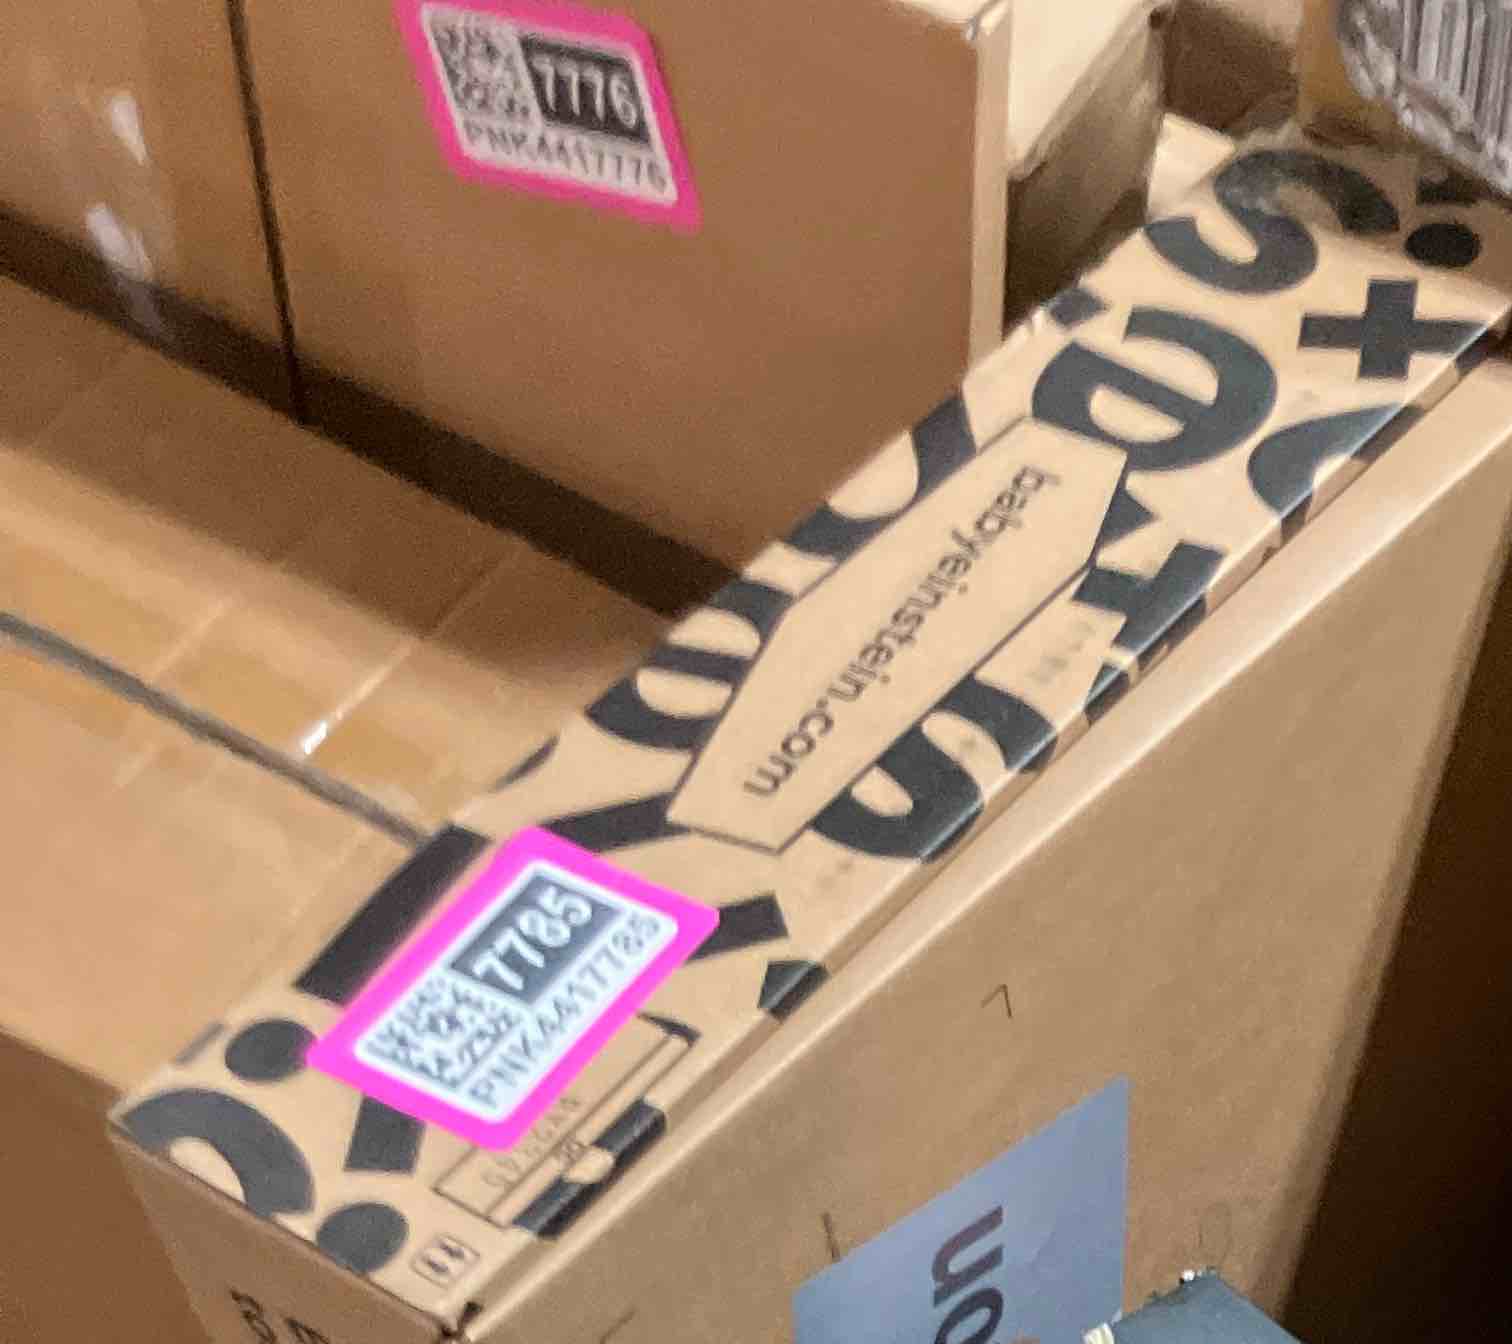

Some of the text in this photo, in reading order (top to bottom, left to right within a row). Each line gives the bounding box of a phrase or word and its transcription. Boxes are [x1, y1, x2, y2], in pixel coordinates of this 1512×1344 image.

[528, 56, 638, 130] 7776
[463, 118, 669, 194] PNK4417776
[743, 465, 1061, 797] babyeinstein.com
[472, 886, 593, 990] 7785
[468, 912, 661, 1108] PNK4417785
